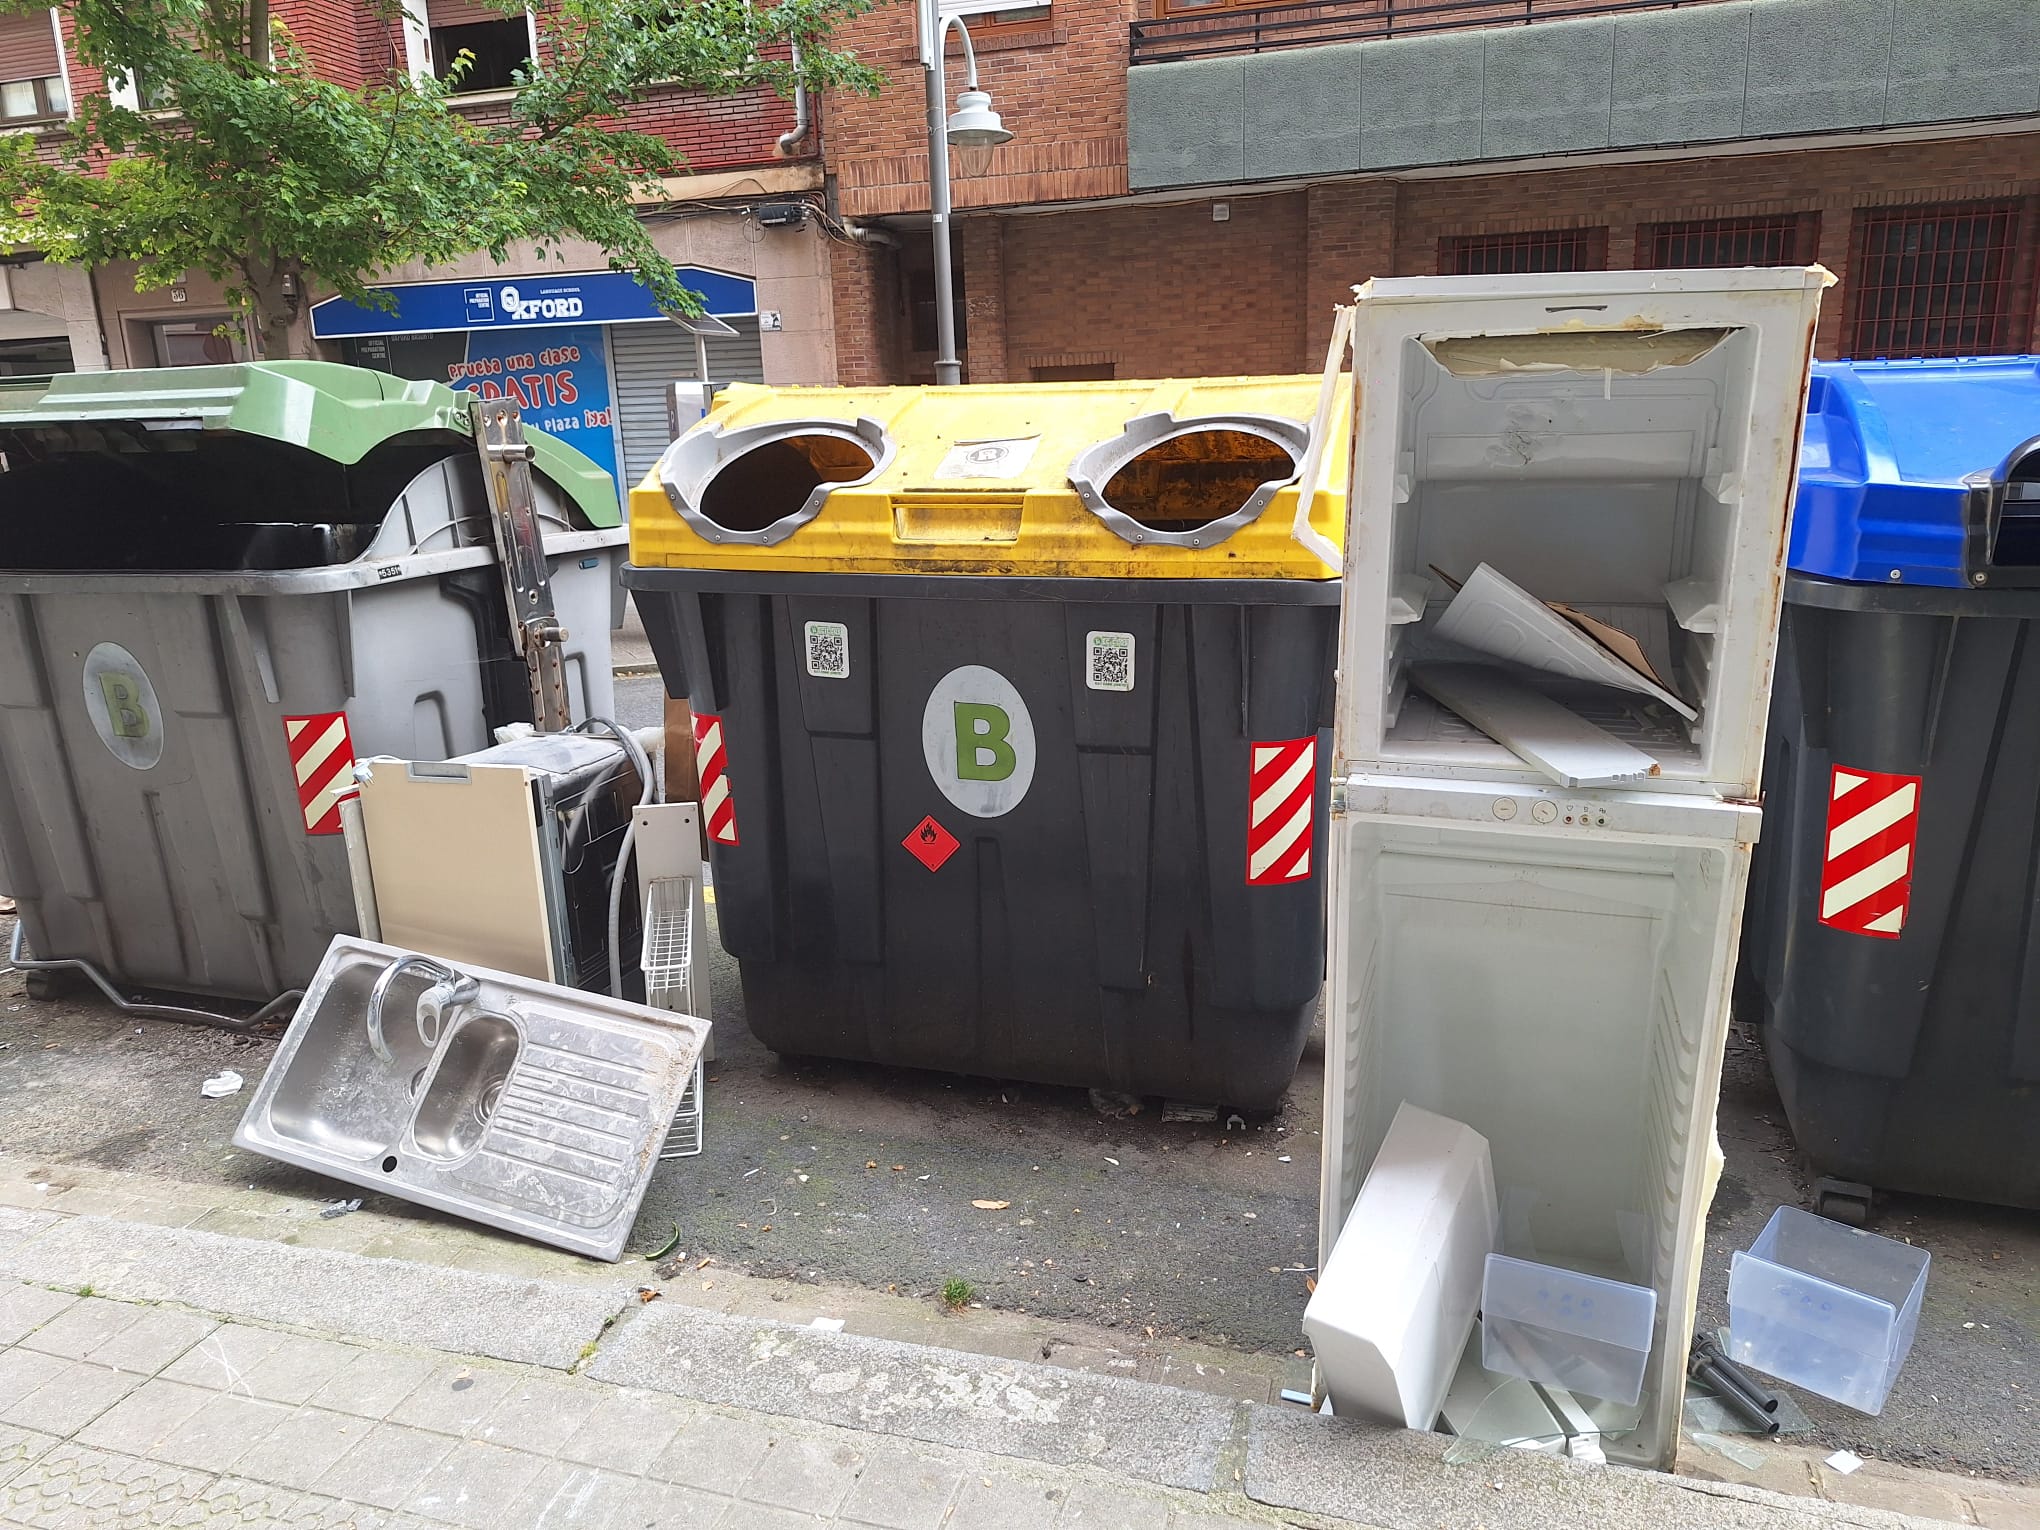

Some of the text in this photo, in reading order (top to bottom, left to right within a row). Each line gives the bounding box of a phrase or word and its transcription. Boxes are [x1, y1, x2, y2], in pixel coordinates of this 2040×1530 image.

[500, 286, 584, 320] OXFORD
[505, 352, 534, 370] una
[538, 345, 580, 366] clase
[98, 671, 150, 738] B
[953, 701, 1017, 781] B
